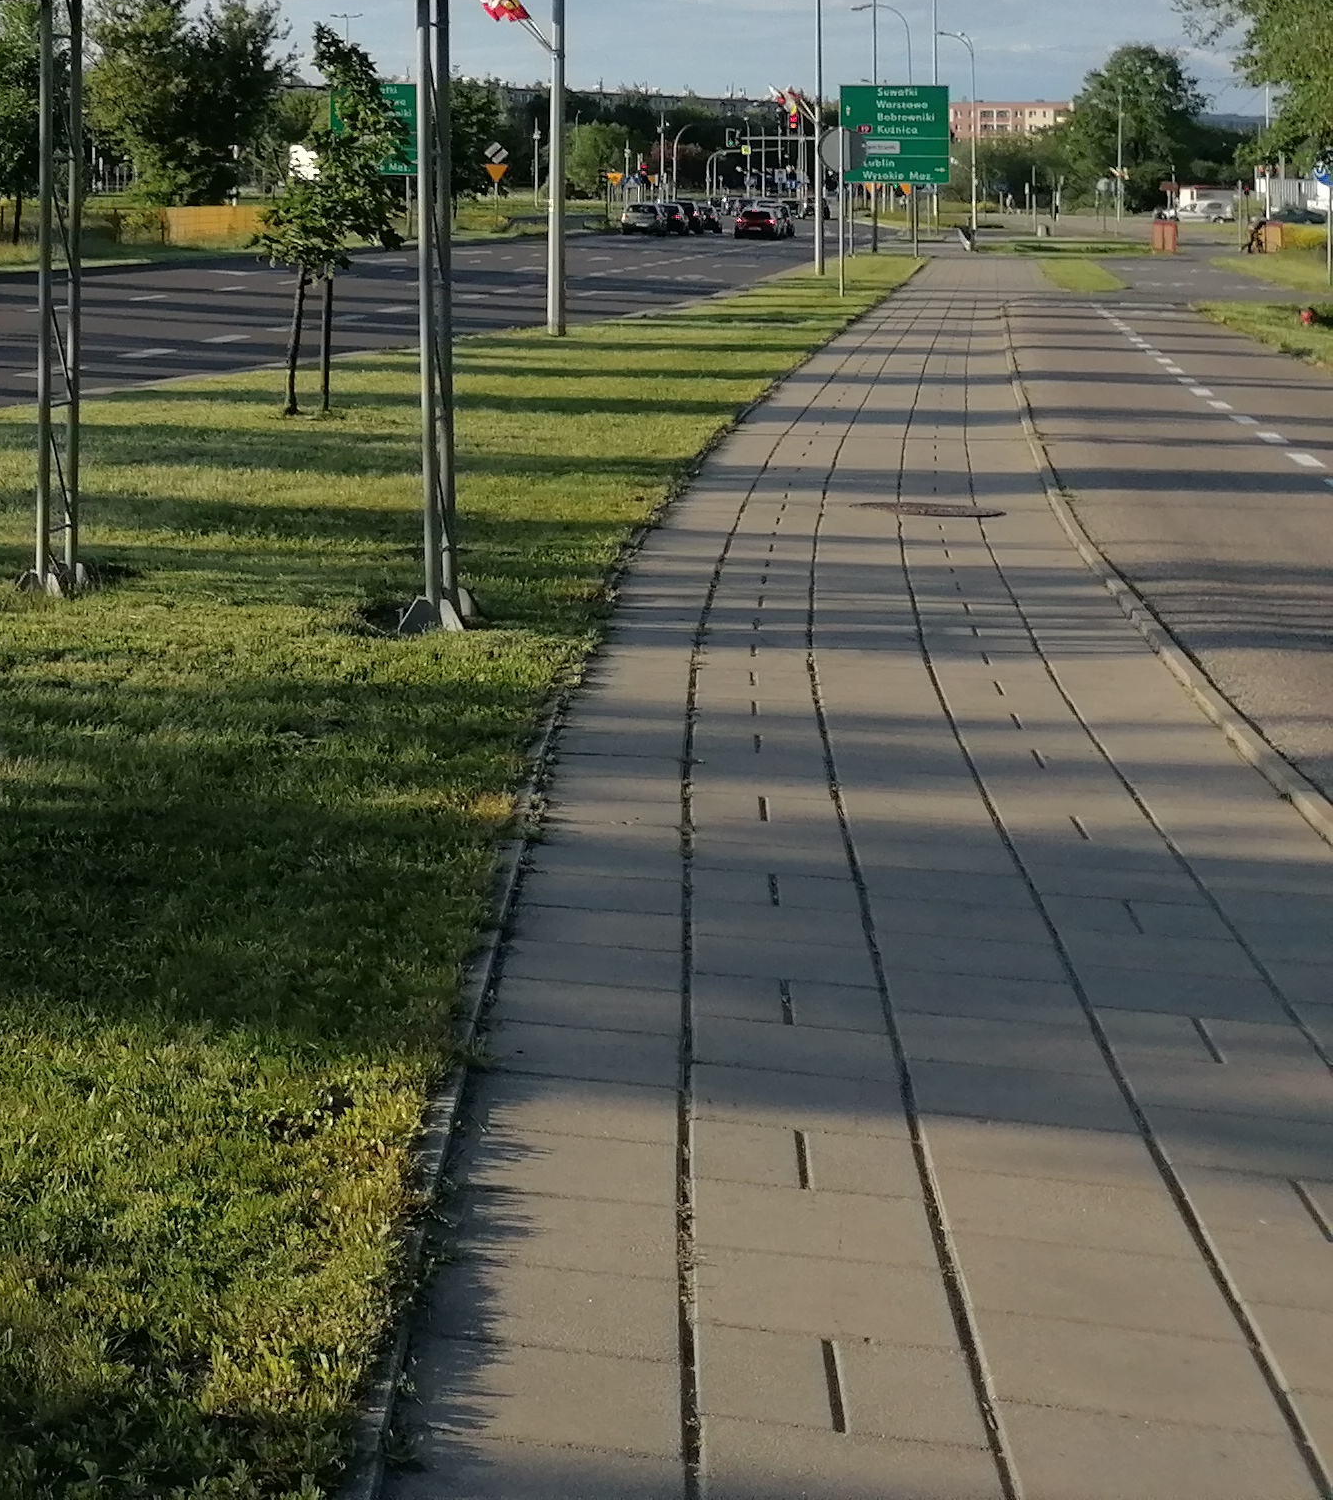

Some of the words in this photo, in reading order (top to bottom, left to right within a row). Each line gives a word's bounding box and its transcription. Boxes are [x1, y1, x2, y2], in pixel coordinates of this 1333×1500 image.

[877, 87, 918, 97] Suwałki
[876, 100, 929, 109] Warszawa
[877, 112, 935, 122] Bobrowniki
[877, 125, 918, 134] Kuźnica
[862, 171, 904, 181] Wysokie
[909, 171, 935, 180] Maz.
